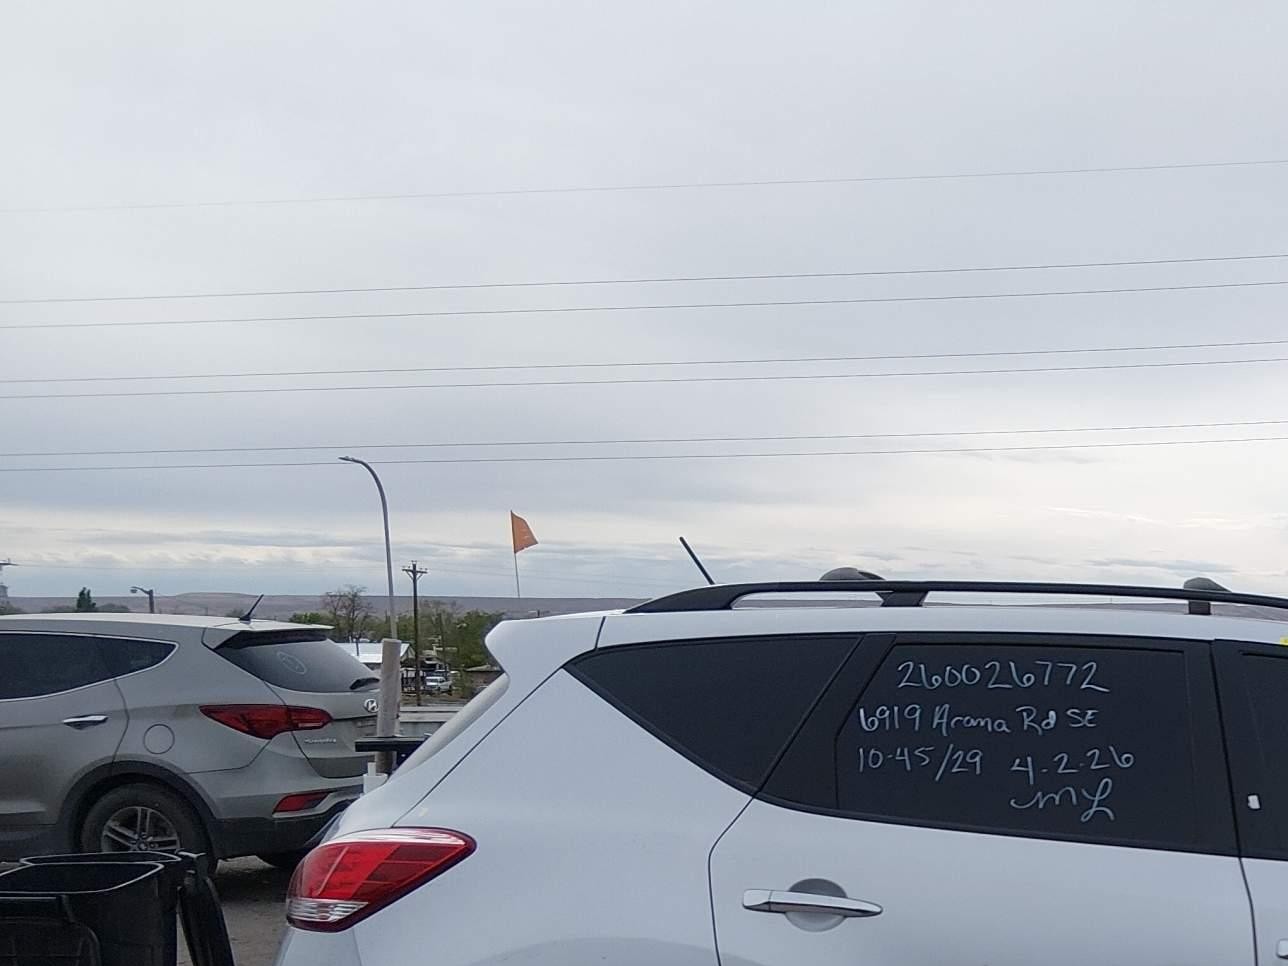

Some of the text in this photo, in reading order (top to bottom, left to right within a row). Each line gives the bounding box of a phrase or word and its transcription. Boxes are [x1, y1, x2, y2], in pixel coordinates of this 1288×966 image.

[897, 661, 1110, 693] 260026772
[859, 704, 921, 732] 6919
[1015, 705, 1057, 736] Rd
[1066, 709, 1099, 727] SE
